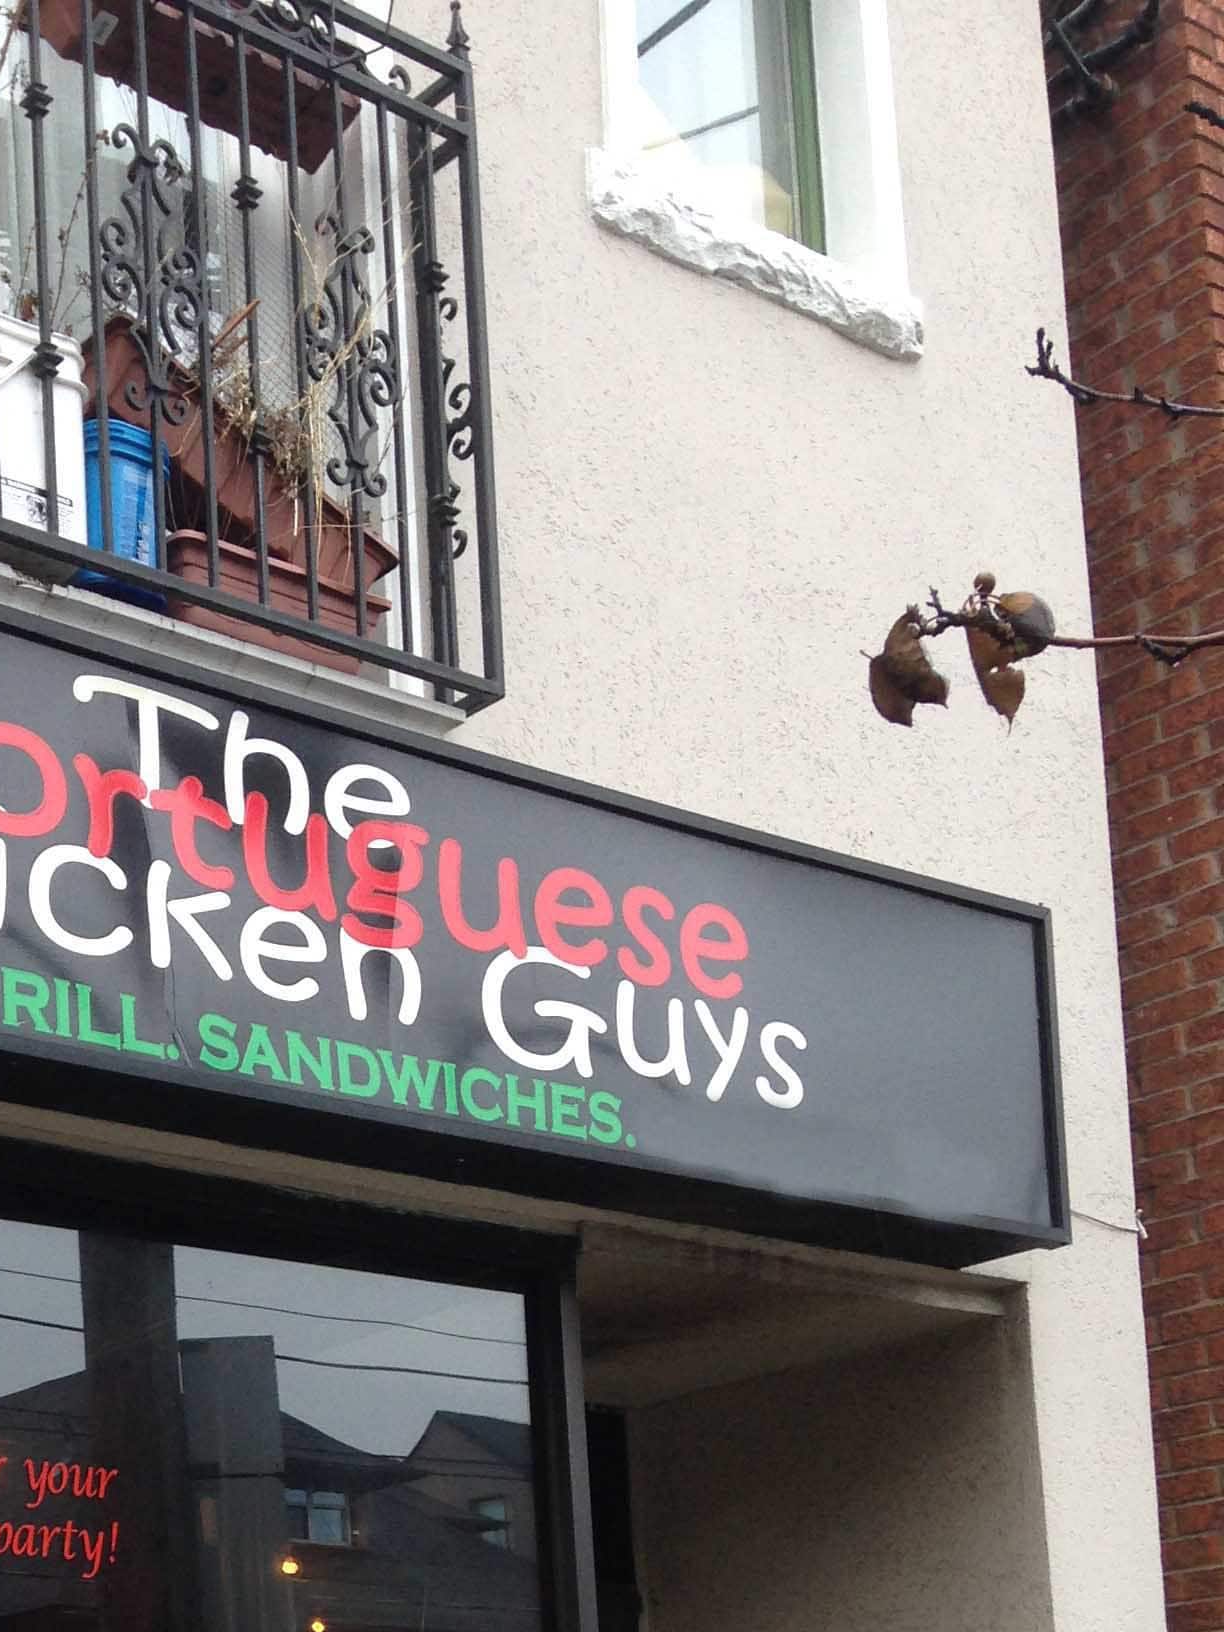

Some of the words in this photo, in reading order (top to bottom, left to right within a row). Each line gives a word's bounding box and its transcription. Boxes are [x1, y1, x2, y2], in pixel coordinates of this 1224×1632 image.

[73, 675, 411, 849] The
[199, 1013, 637, 1148] SANDWICHES.
[482, 946, 808, 1109] Guys
[23, 1456, 119, 1509] your
